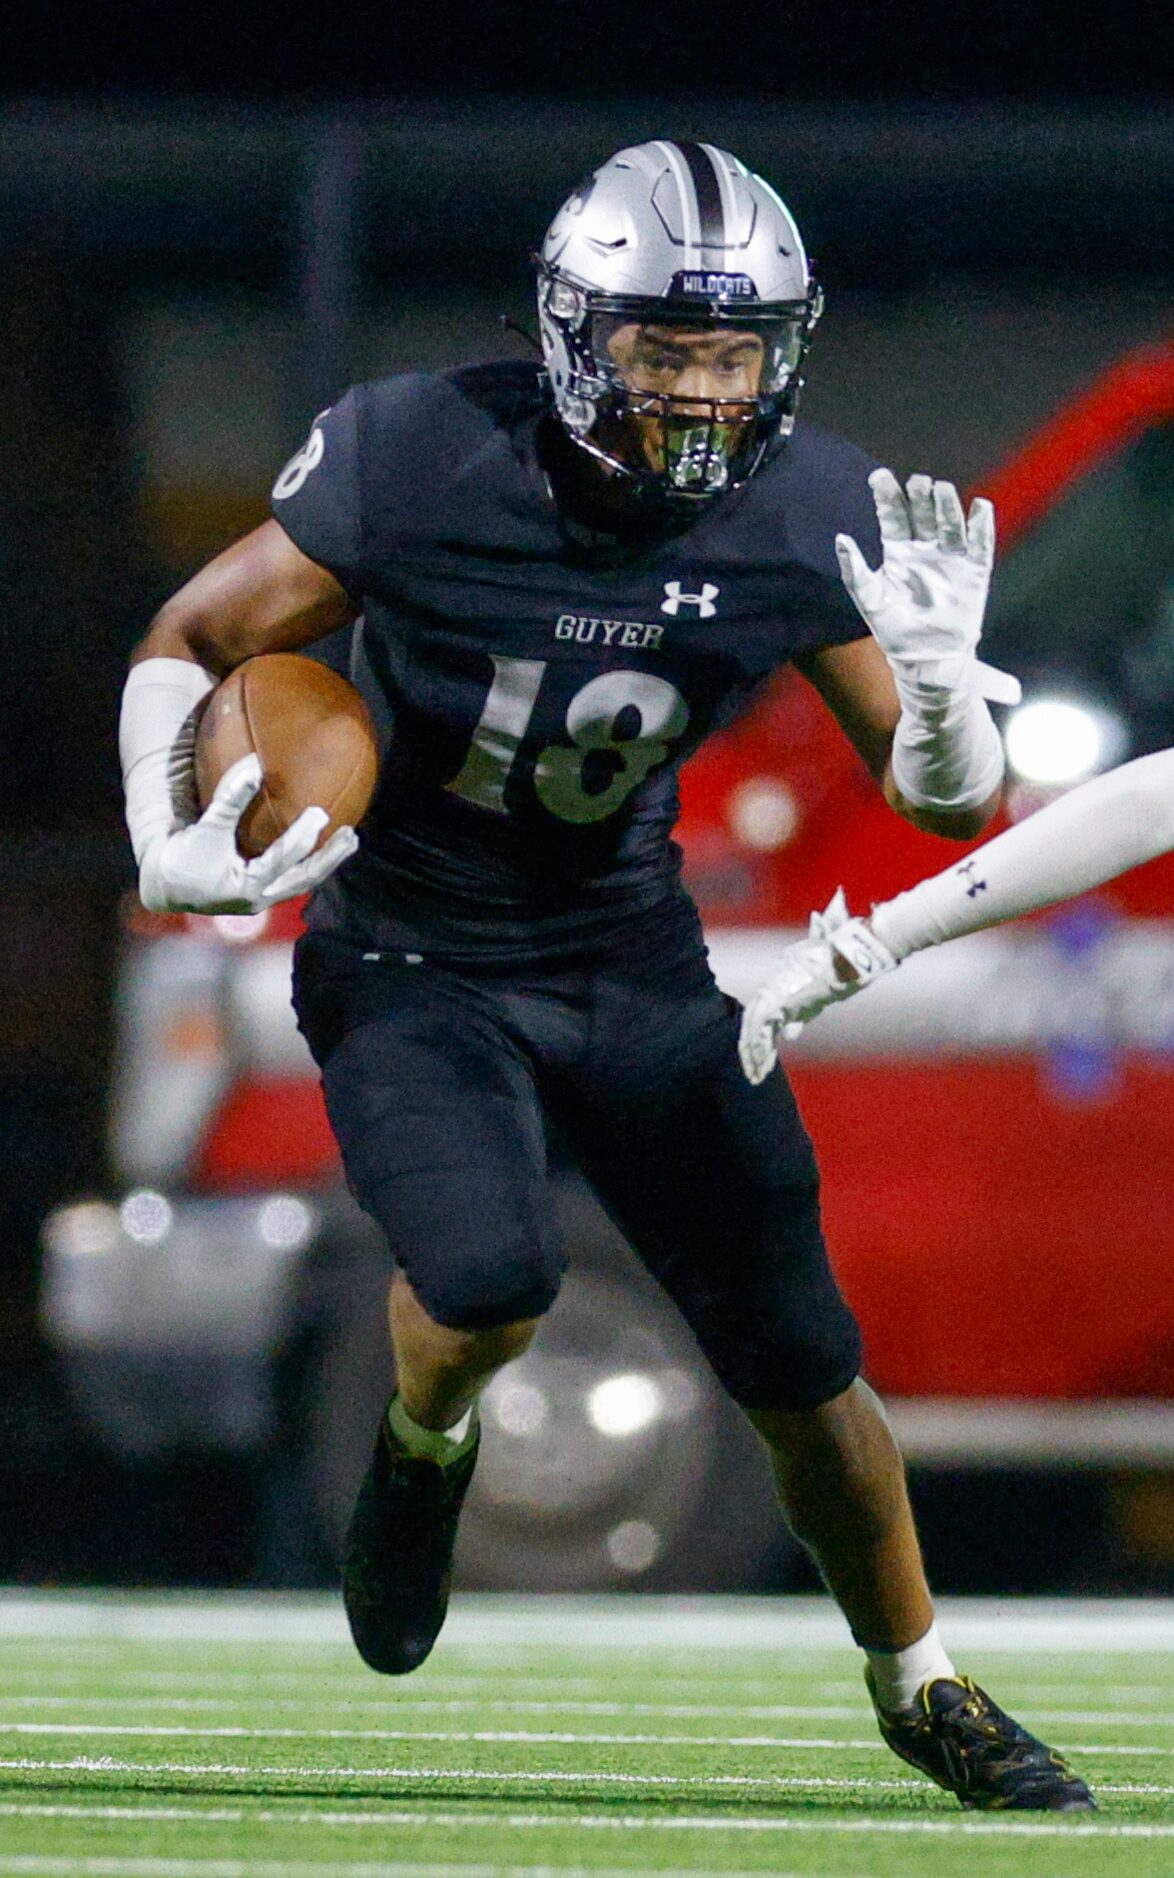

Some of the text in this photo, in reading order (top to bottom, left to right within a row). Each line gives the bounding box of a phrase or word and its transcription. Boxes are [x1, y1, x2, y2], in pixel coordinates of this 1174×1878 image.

[683, 275, 751, 295] WILDCATS
[555, 614, 664, 650] GUYER
[441, 654, 690, 825] 18
